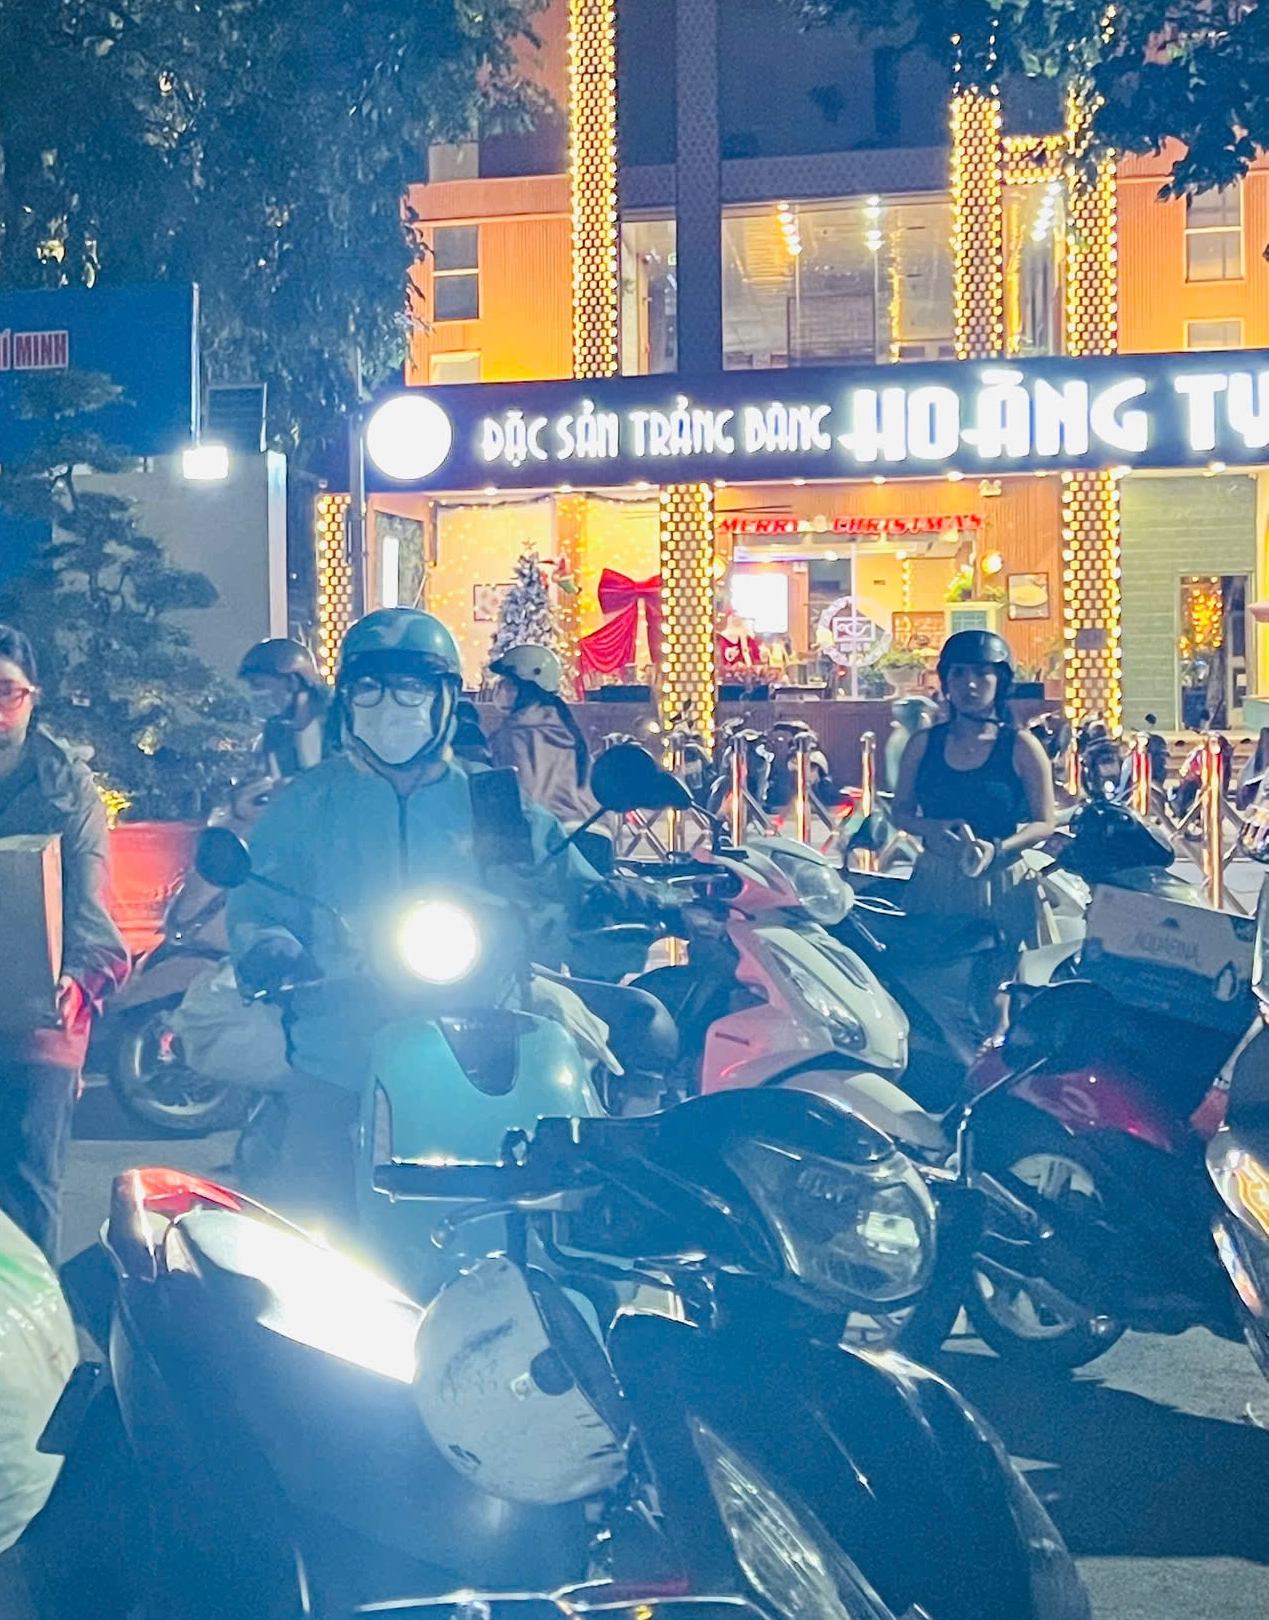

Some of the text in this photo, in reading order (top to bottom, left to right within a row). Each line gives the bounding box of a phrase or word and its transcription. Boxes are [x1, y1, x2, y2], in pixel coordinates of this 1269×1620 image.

[13, 330, 69, 371] MINH
[481, 410, 549, 468] ĐẶC
[556, 398, 619, 460] SẢN
[629, 394, 735, 458] TRẢNG
[718, 512, 986, 535] MERRY CHRISTMAS
